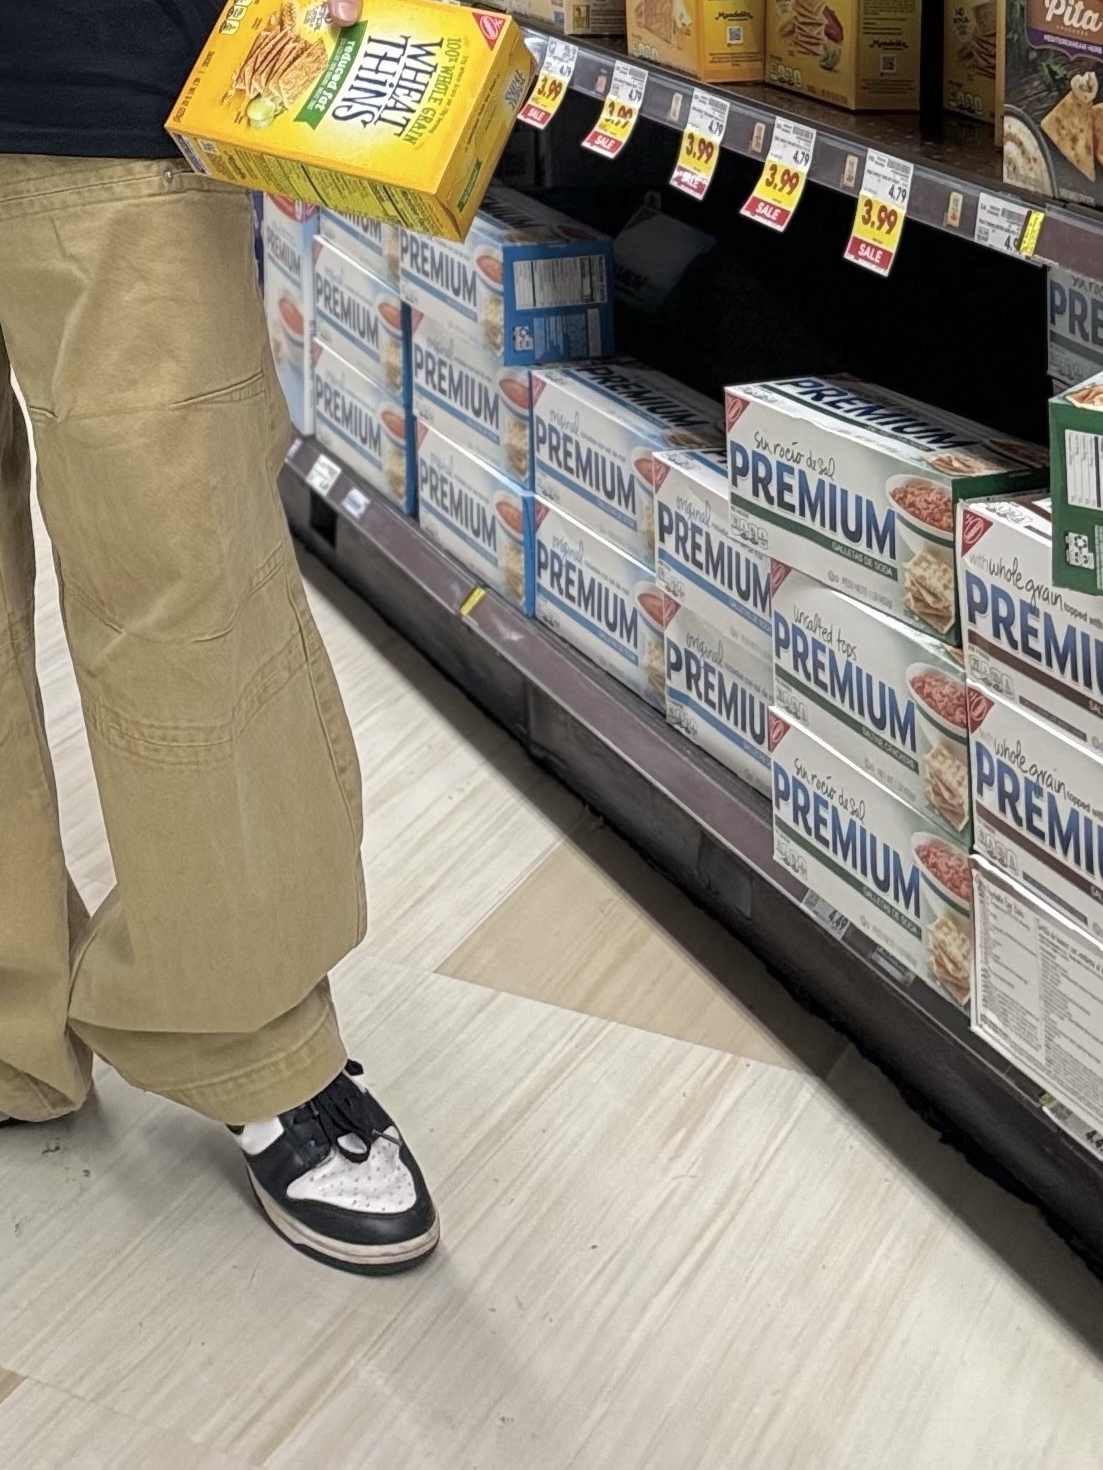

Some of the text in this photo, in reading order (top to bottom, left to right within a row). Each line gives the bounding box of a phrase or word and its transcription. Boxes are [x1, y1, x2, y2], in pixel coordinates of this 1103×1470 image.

[314, 38, 357, 113] reduced fat
[373, 36, 445, 139] WHEAT
[402, 63, 453, 146] WHOLE GRAIN
[537, 79, 563, 102] 3.99
[529, 110, 545, 122] SALE
[595, 134, 614, 150] SALE
[685, 132, 715, 164] 3.99
[765, 163, 800, 196] 3.99
[793, 150, 810, 168] 4.79
[888, 184, 907, 202] 4.79
[755, 200, 780, 221] SALE
[861, 198, 898, 236] 3.99
[400, 230, 478, 307] PREMIUM
[857, 243, 883, 264] SALE
[315, 272, 379, 349] PREMIUM
[315, 373, 382, 458] PREMIUM
[413, 336, 499, 432] PREMIUM
[784, 379, 980, 451] PREMIUM
[534, 415, 637, 516] PREMIUM
[729, 439, 898, 561] PREMIUM
[419, 456, 498, 553] PREMIUM
[537, 537, 639, 650] PREMIUM
[657, 499, 773, 619] PREMIUM
[832, 540, 865, 565] GALLETAS
[874, 558, 894, 578] SODA
[988, 557, 1024, 591] whole
[1025, 579, 1064, 617] grain
[666, 636, 765, 746] PREMIU
[773, 609, 918, 756] PREMIUM
[994, 738, 1027, 774] whole
[1026, 766, 1067, 802] grain
[772, 759, 920, 920] PREMIUM
